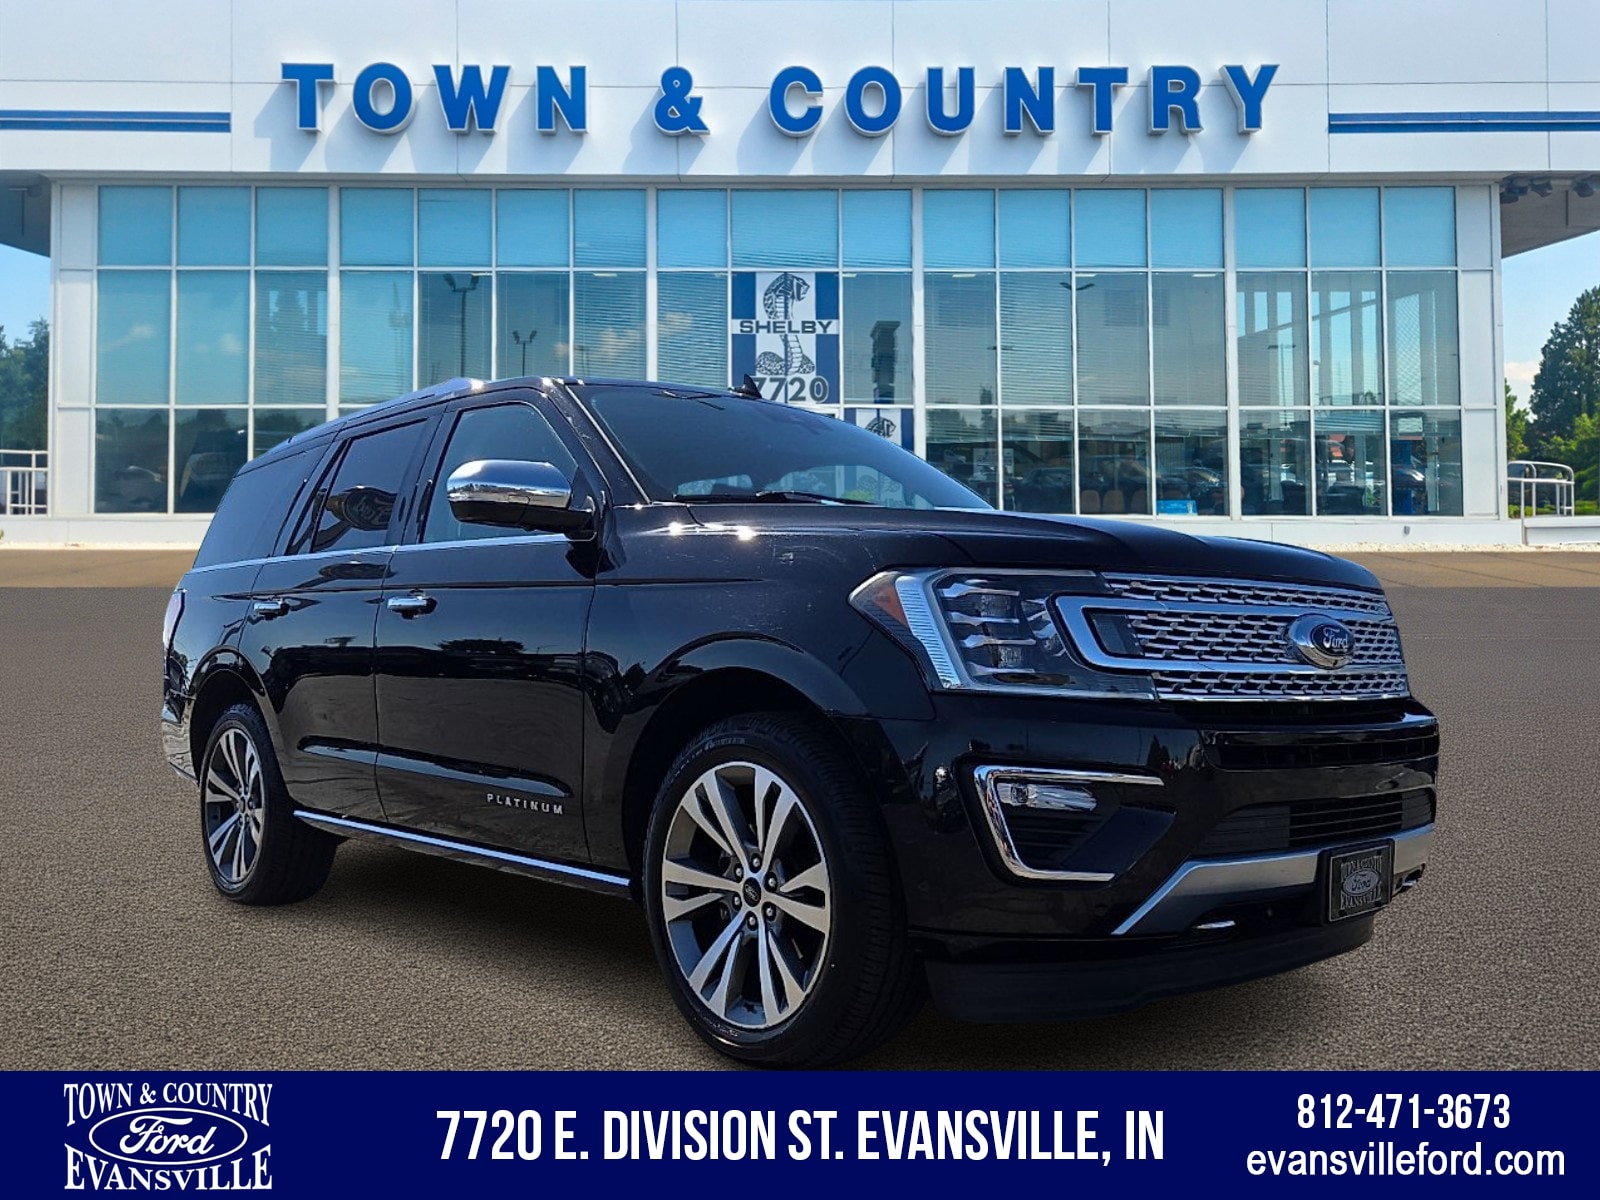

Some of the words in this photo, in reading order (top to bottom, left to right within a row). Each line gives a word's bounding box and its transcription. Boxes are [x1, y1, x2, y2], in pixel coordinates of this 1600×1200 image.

[281, 62, 589, 134] TOWN
[654, 65, 711, 136] &
[767, 63, 1281, 137] COUNTRY
[739, 320, 833, 335] SHELBY
[751, 375, 829, 402] 7720
[1322, 626, 1349, 649] Ford
[486, 793, 564, 815] PLATINUM
